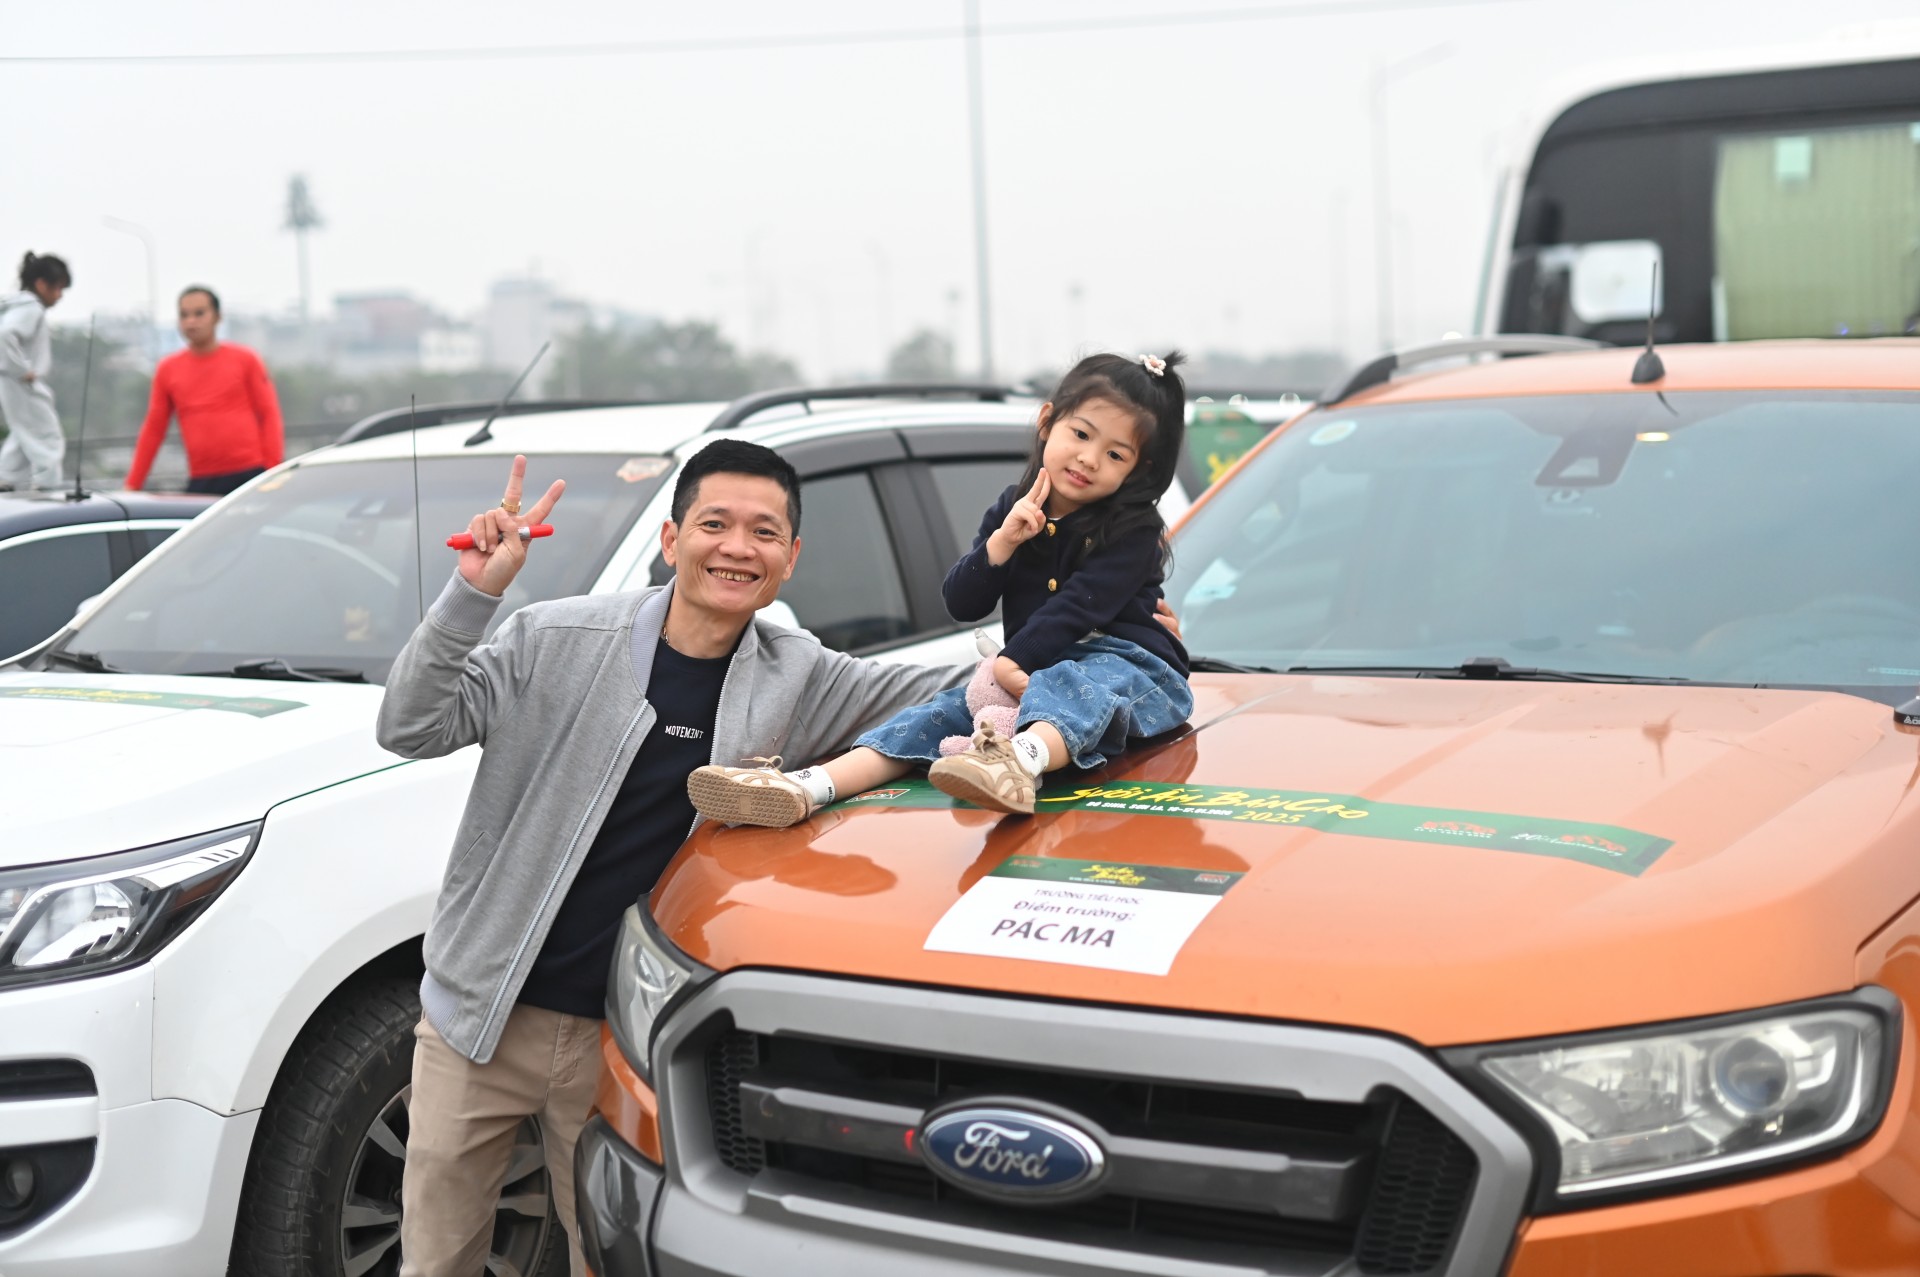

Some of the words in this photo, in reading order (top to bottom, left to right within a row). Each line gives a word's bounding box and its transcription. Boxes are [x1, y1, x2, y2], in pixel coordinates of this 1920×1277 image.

[664, 725, 704, 739] MOVEMENT
[1232, 810, 1306, 823] 2025
[991, 917, 1060, 941] PÁC
[1060, 925, 1116, 948] MA
[954, 1121, 1053, 1179] Ford
